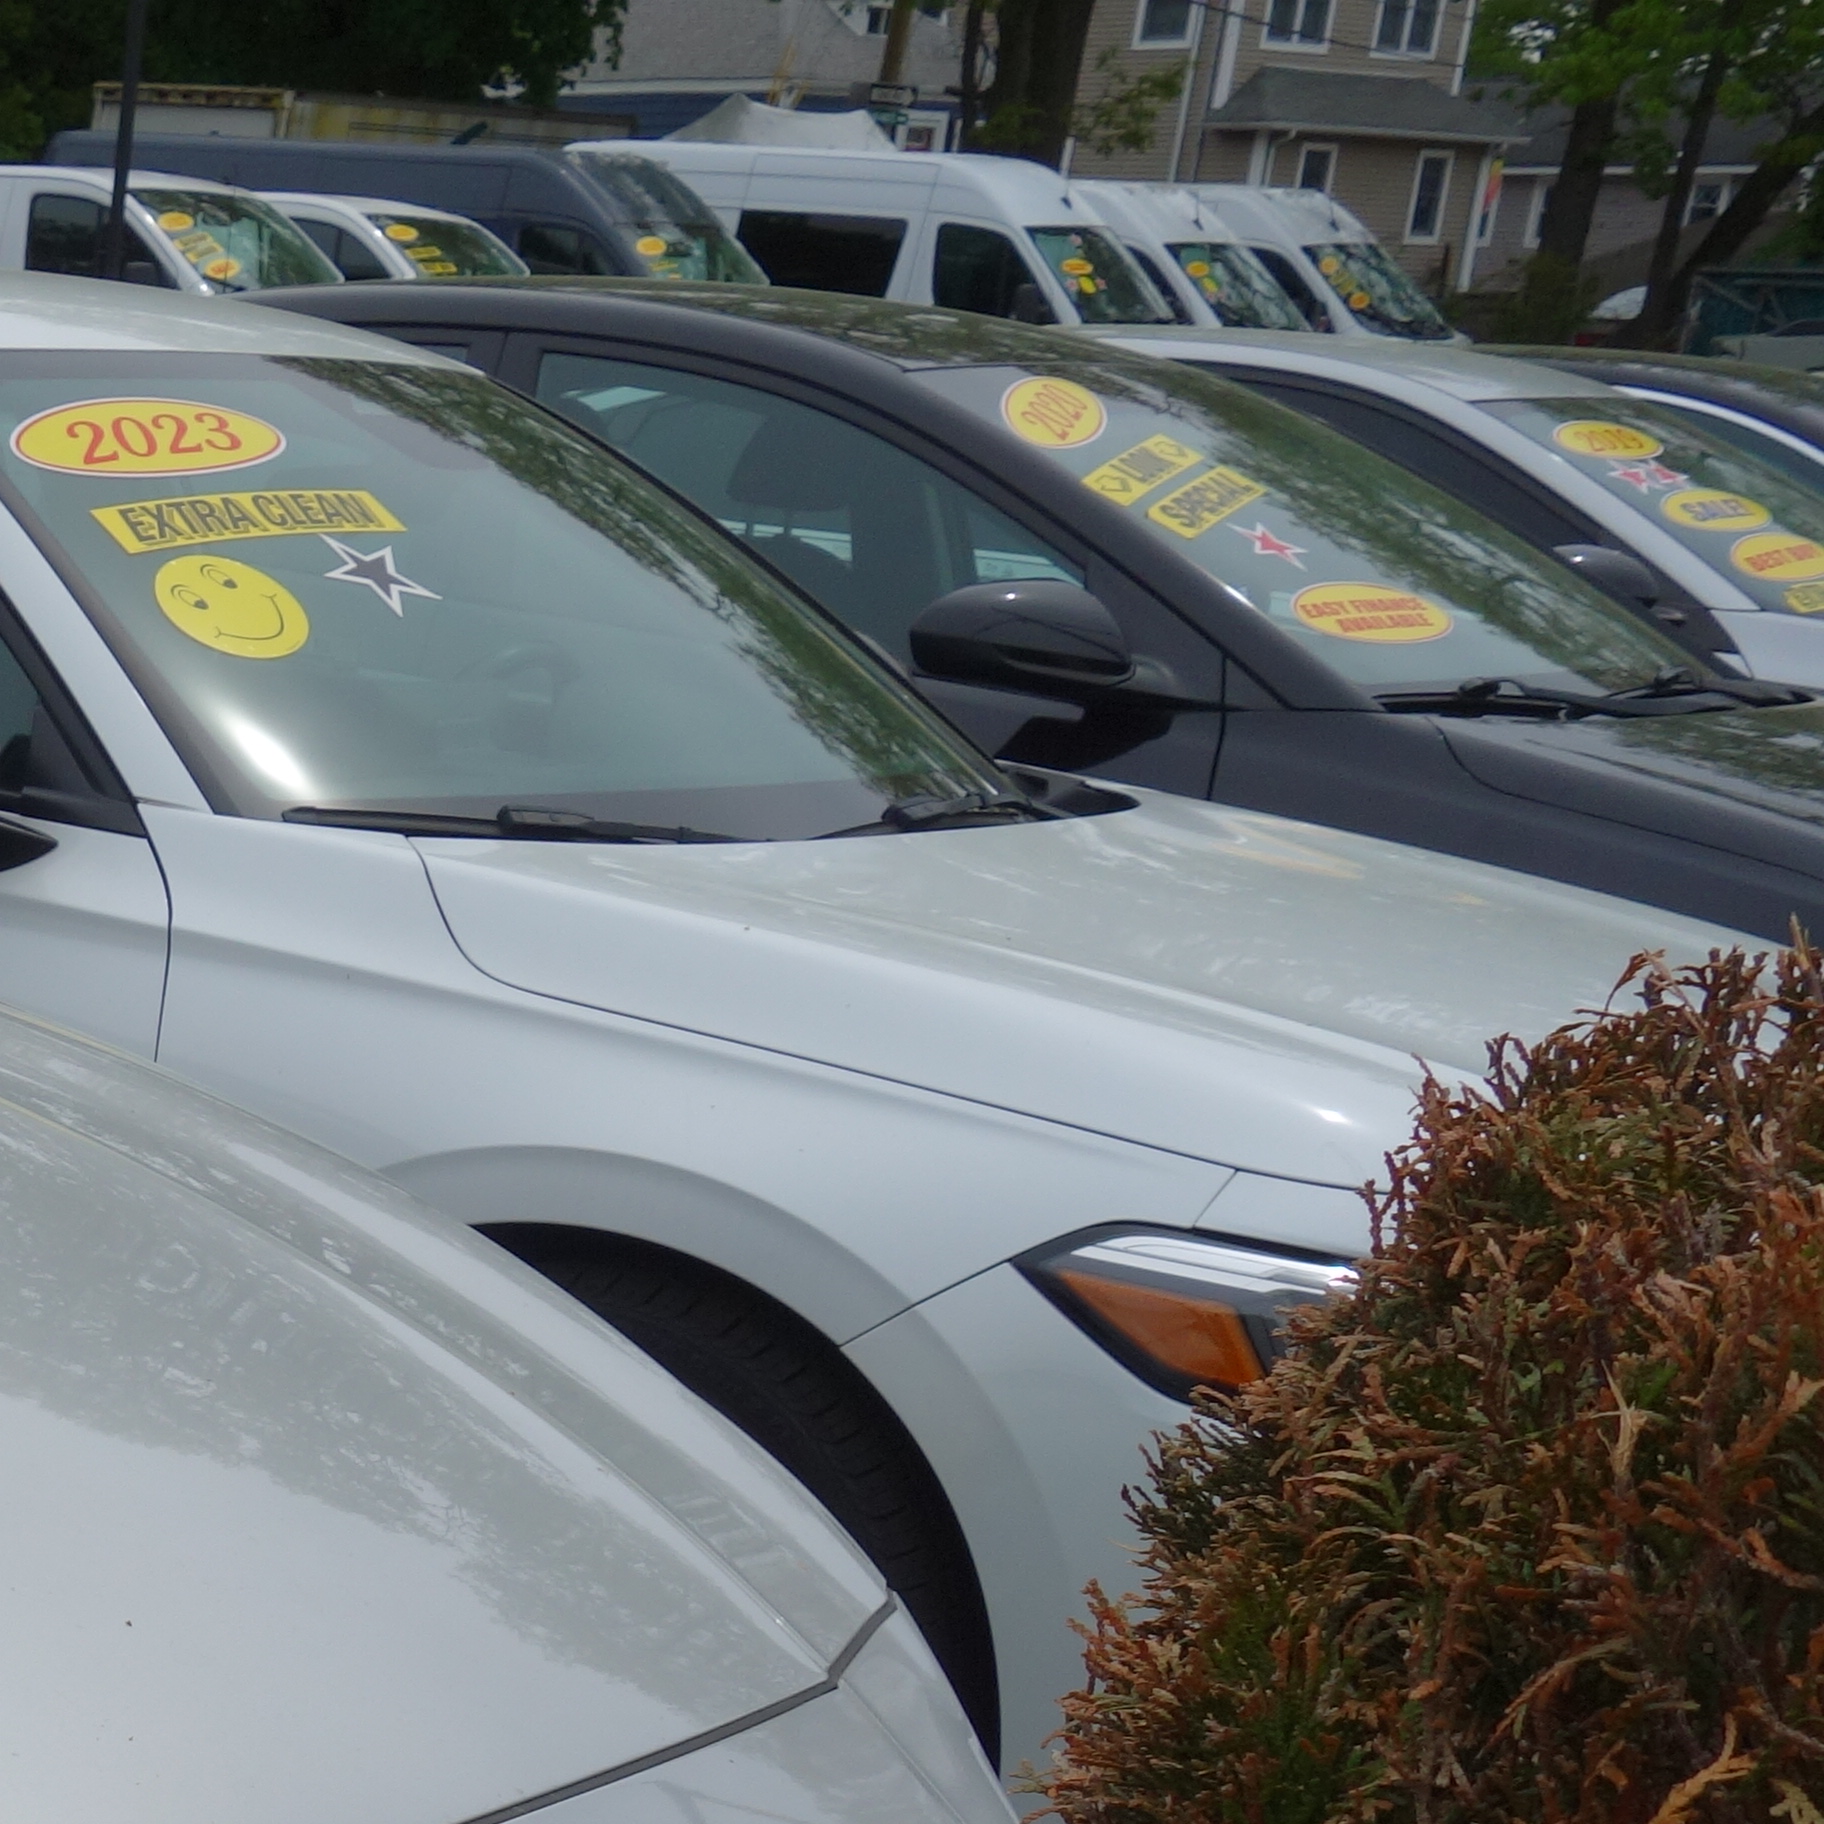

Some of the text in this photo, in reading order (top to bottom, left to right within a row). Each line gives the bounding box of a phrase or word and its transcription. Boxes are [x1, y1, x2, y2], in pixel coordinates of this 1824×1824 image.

[65, 412, 244, 466] 2023
[1019, 382, 1089, 442] 2020
[117, 491, 381, 544] EXTRA CLEAN
[1157, 471, 1256, 529] SPECIAL
[1299, 600, 1350, 619] EASY
